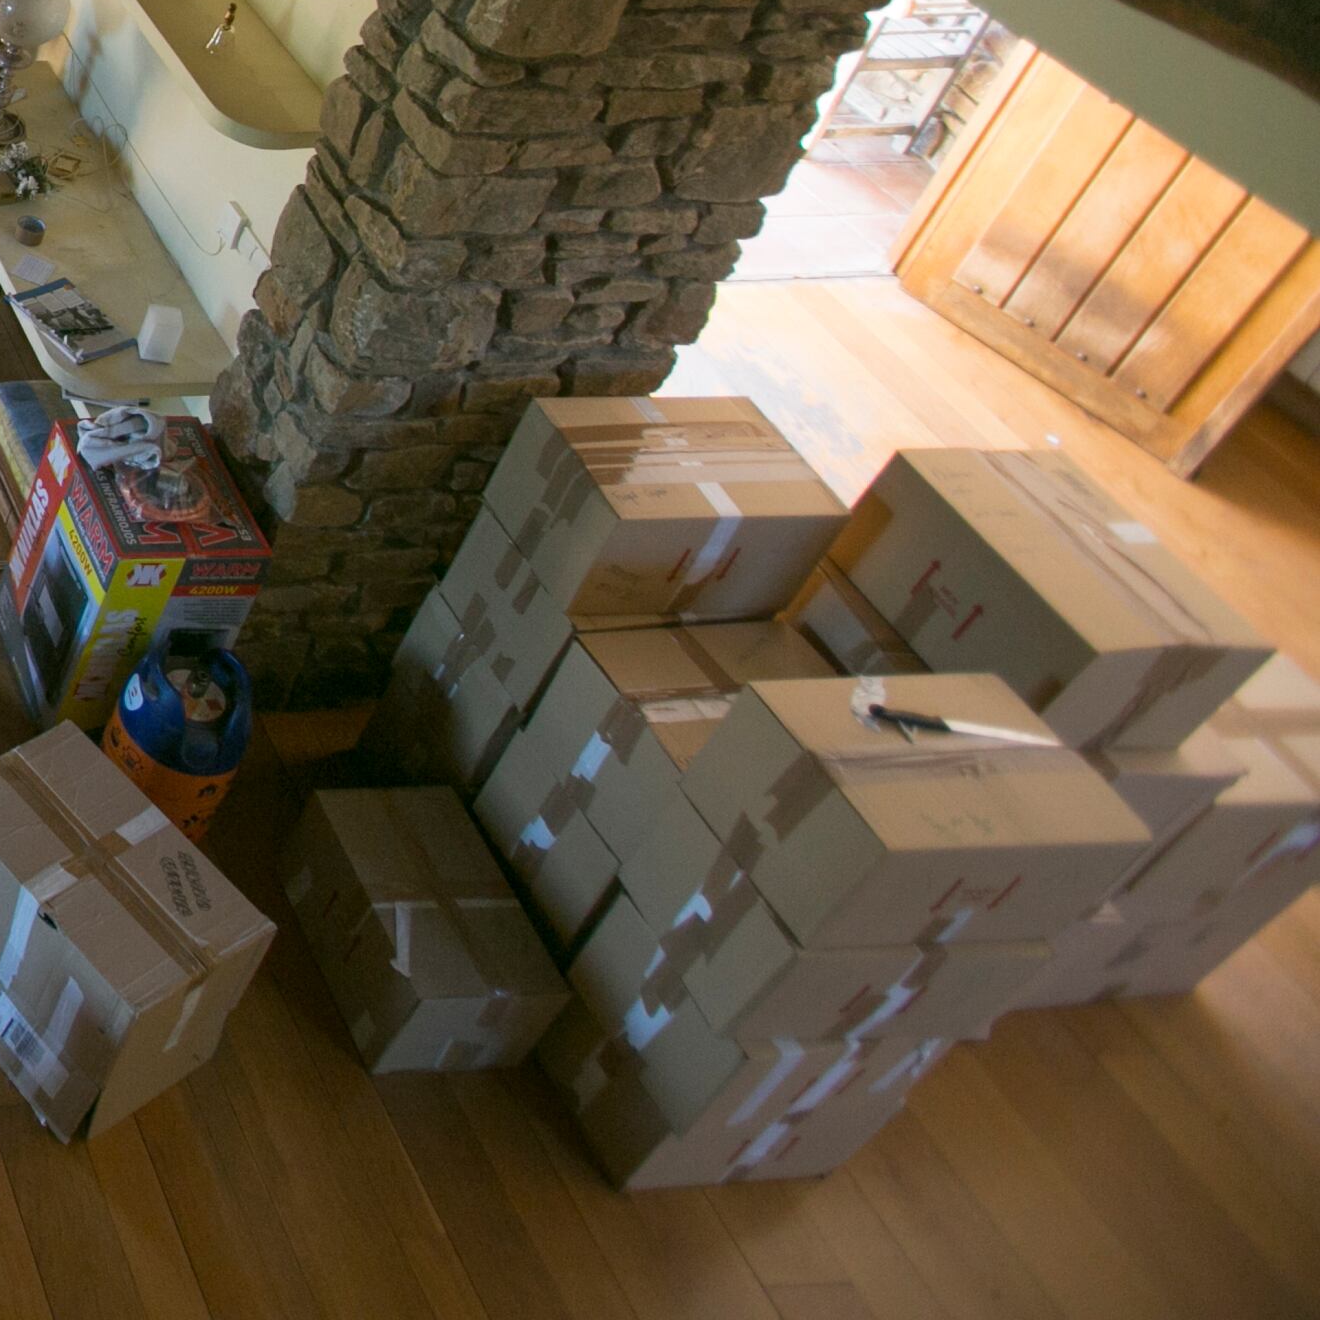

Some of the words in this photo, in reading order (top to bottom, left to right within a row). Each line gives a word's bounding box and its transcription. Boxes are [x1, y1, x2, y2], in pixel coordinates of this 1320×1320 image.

[17, 477, 48, 564] NIKLAS
[71, 474, 114, 573] WARM
[100, 482, 137, 546] INFRARROJOS
[69, 529, 92, 577] 4200W
[191, 563, 262, 576] WARM
[188, 585, 240, 596] 4200W
